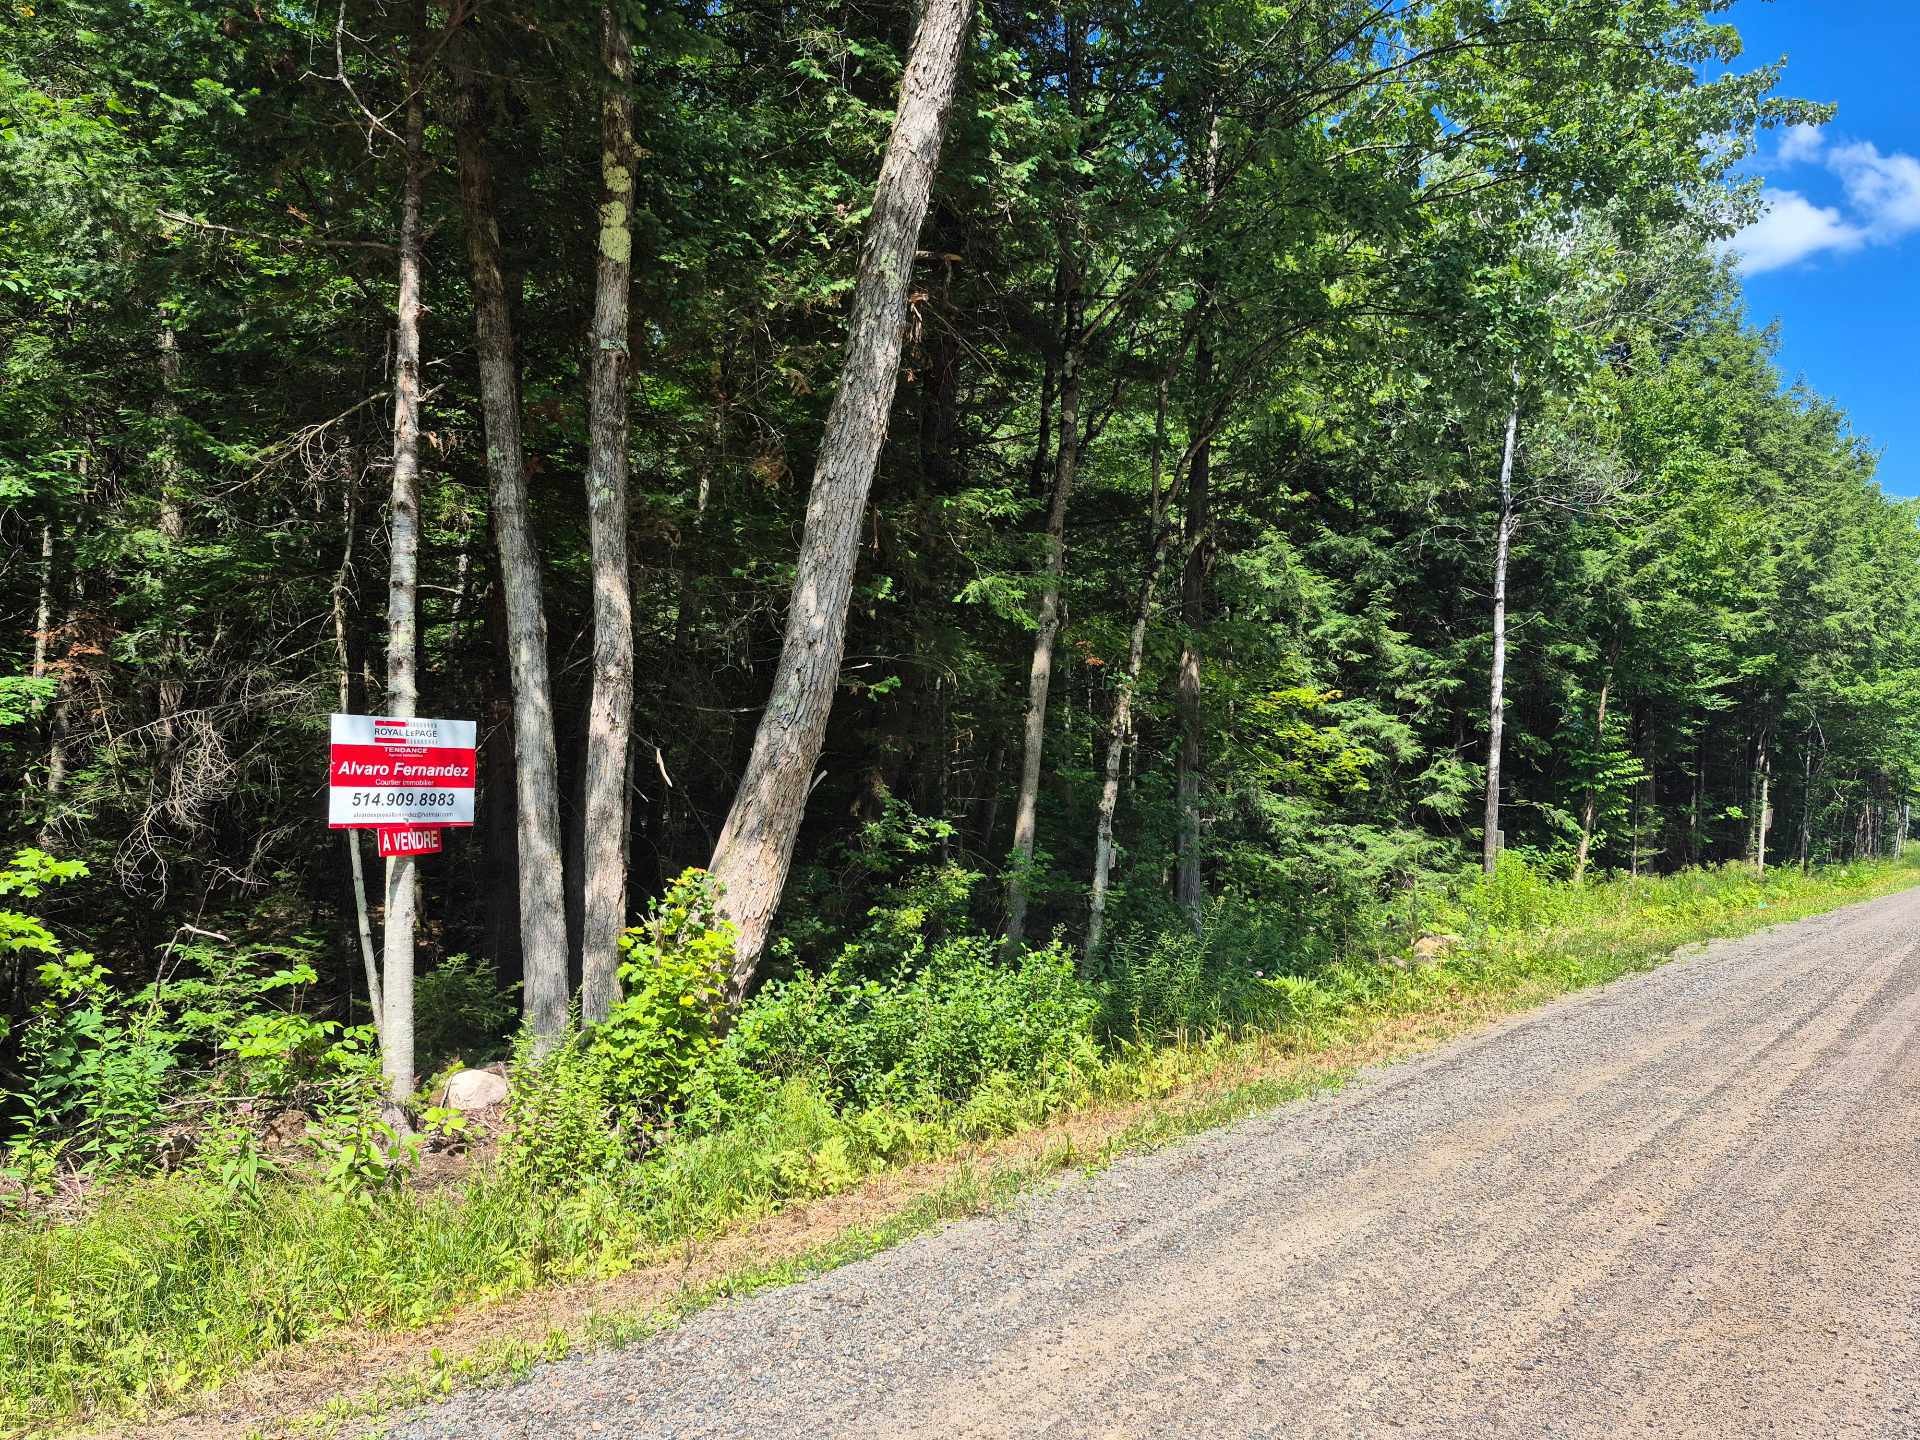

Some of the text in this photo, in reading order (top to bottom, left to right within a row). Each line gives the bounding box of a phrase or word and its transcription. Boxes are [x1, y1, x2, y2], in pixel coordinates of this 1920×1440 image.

[375, 728, 403, 736] ROYAL
[384, 746, 428, 754] TENDANCE
[337, 761, 469, 777] Alvaro Fernandez
[375, 778, 401, 786] Courtier
[352, 792, 455, 807] 514.909.8983
[393, 830, 439, 850] VENDRE
